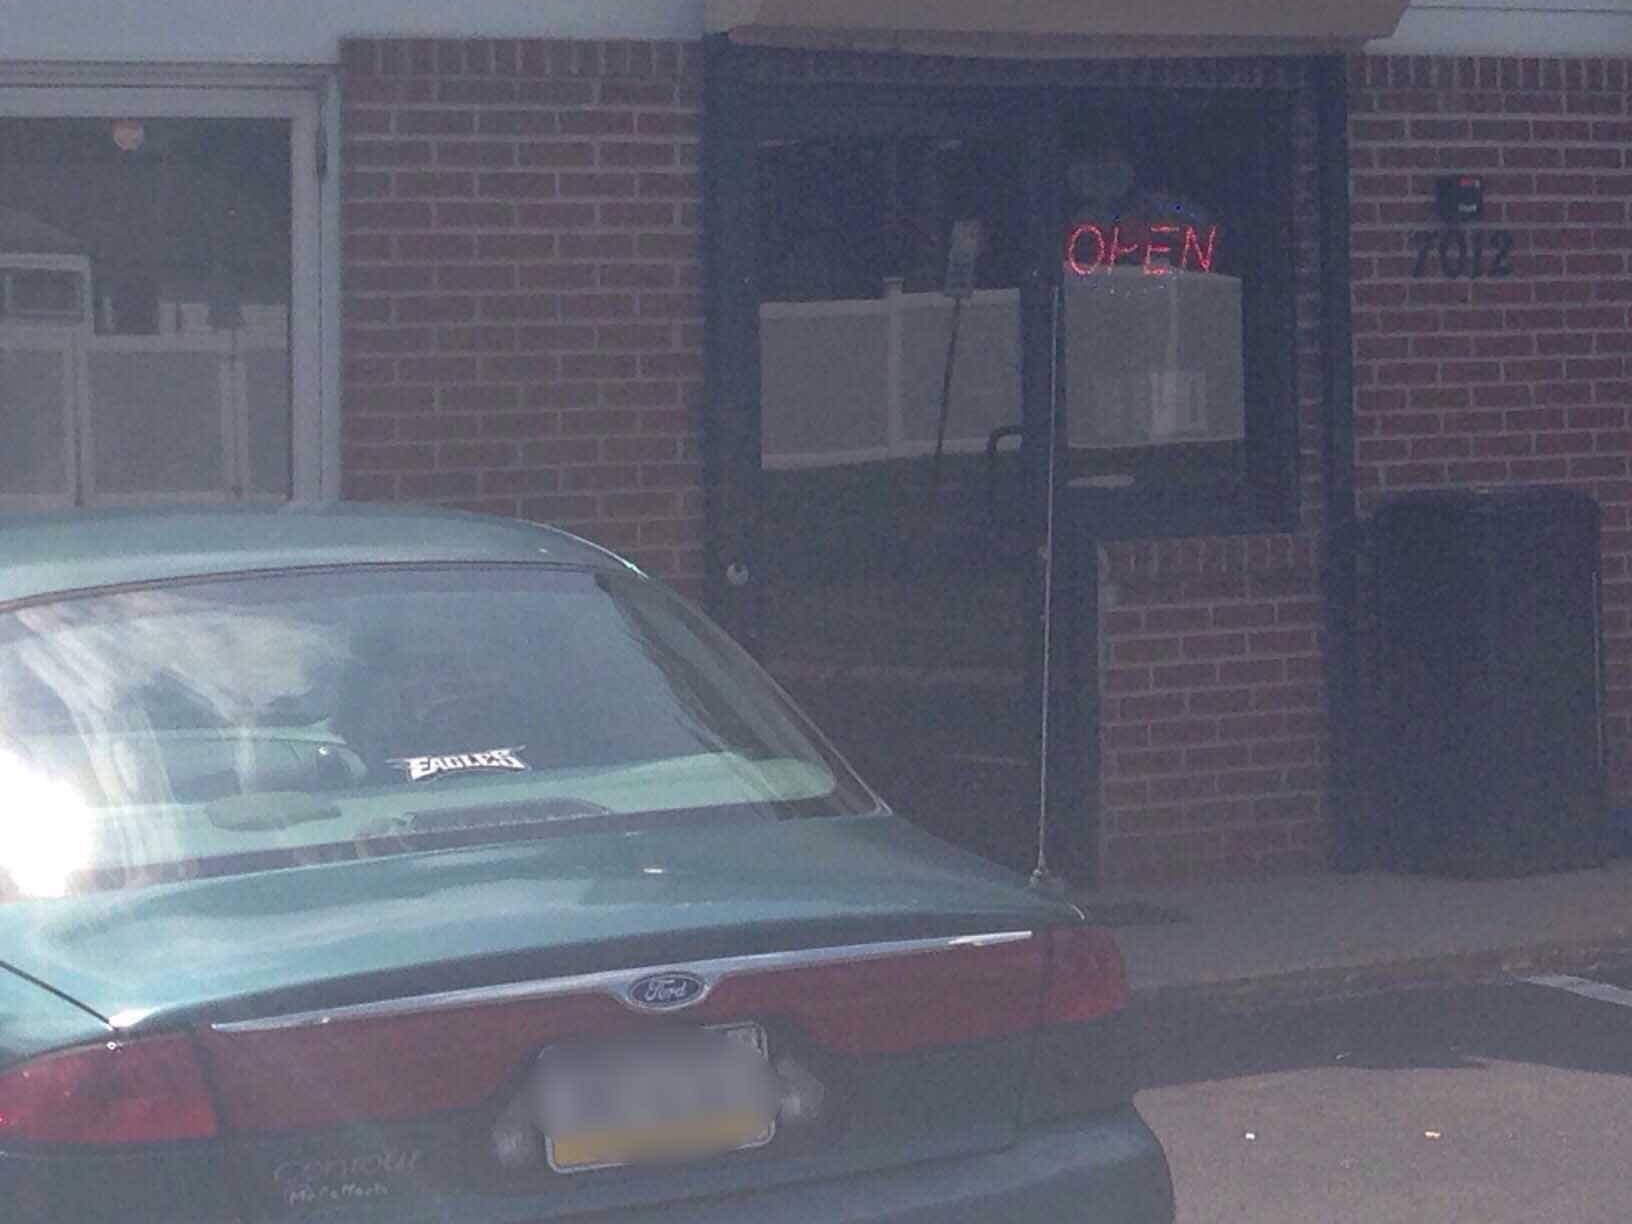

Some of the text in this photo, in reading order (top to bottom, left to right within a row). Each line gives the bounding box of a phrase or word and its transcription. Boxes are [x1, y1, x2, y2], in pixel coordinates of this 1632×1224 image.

[1065, 224, 1217, 275] OPEN
[1409, 228, 1513, 278] 7012
[405, 748, 526, 780] EAGLES
[643, 978, 688, 1001] Ford
